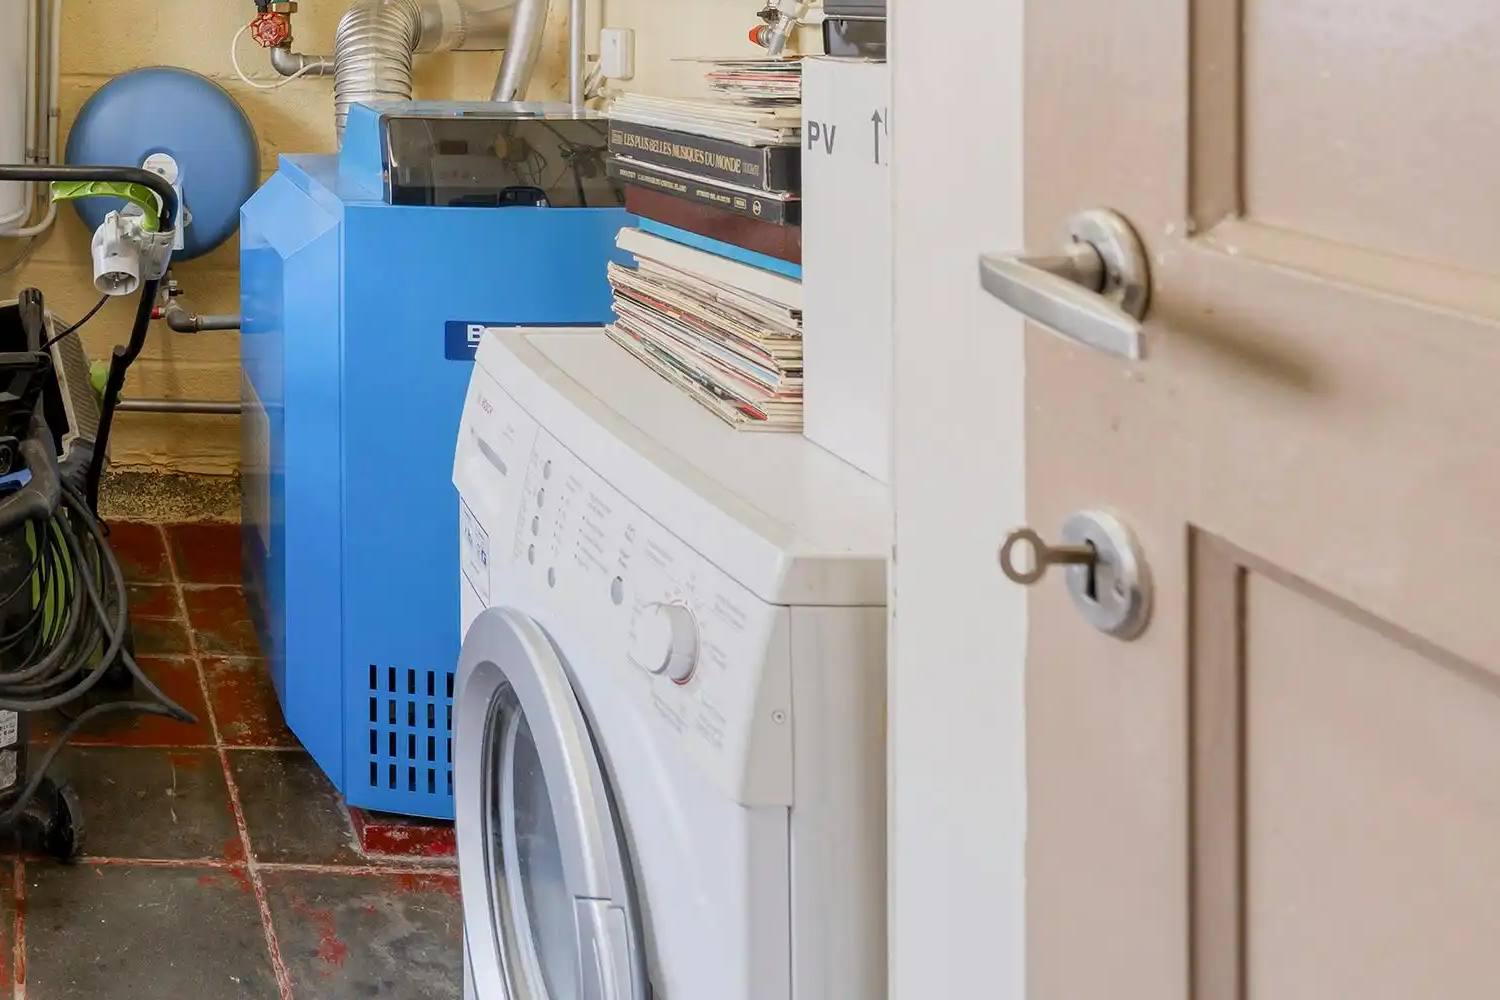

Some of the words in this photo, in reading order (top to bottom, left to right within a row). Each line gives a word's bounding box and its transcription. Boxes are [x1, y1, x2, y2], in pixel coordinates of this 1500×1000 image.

[807, 120, 836, 155] PV
[649, 138, 672, 156] BELLES
[704, 151, 716, 167] DU
[715, 154, 741, 174] MONDE
